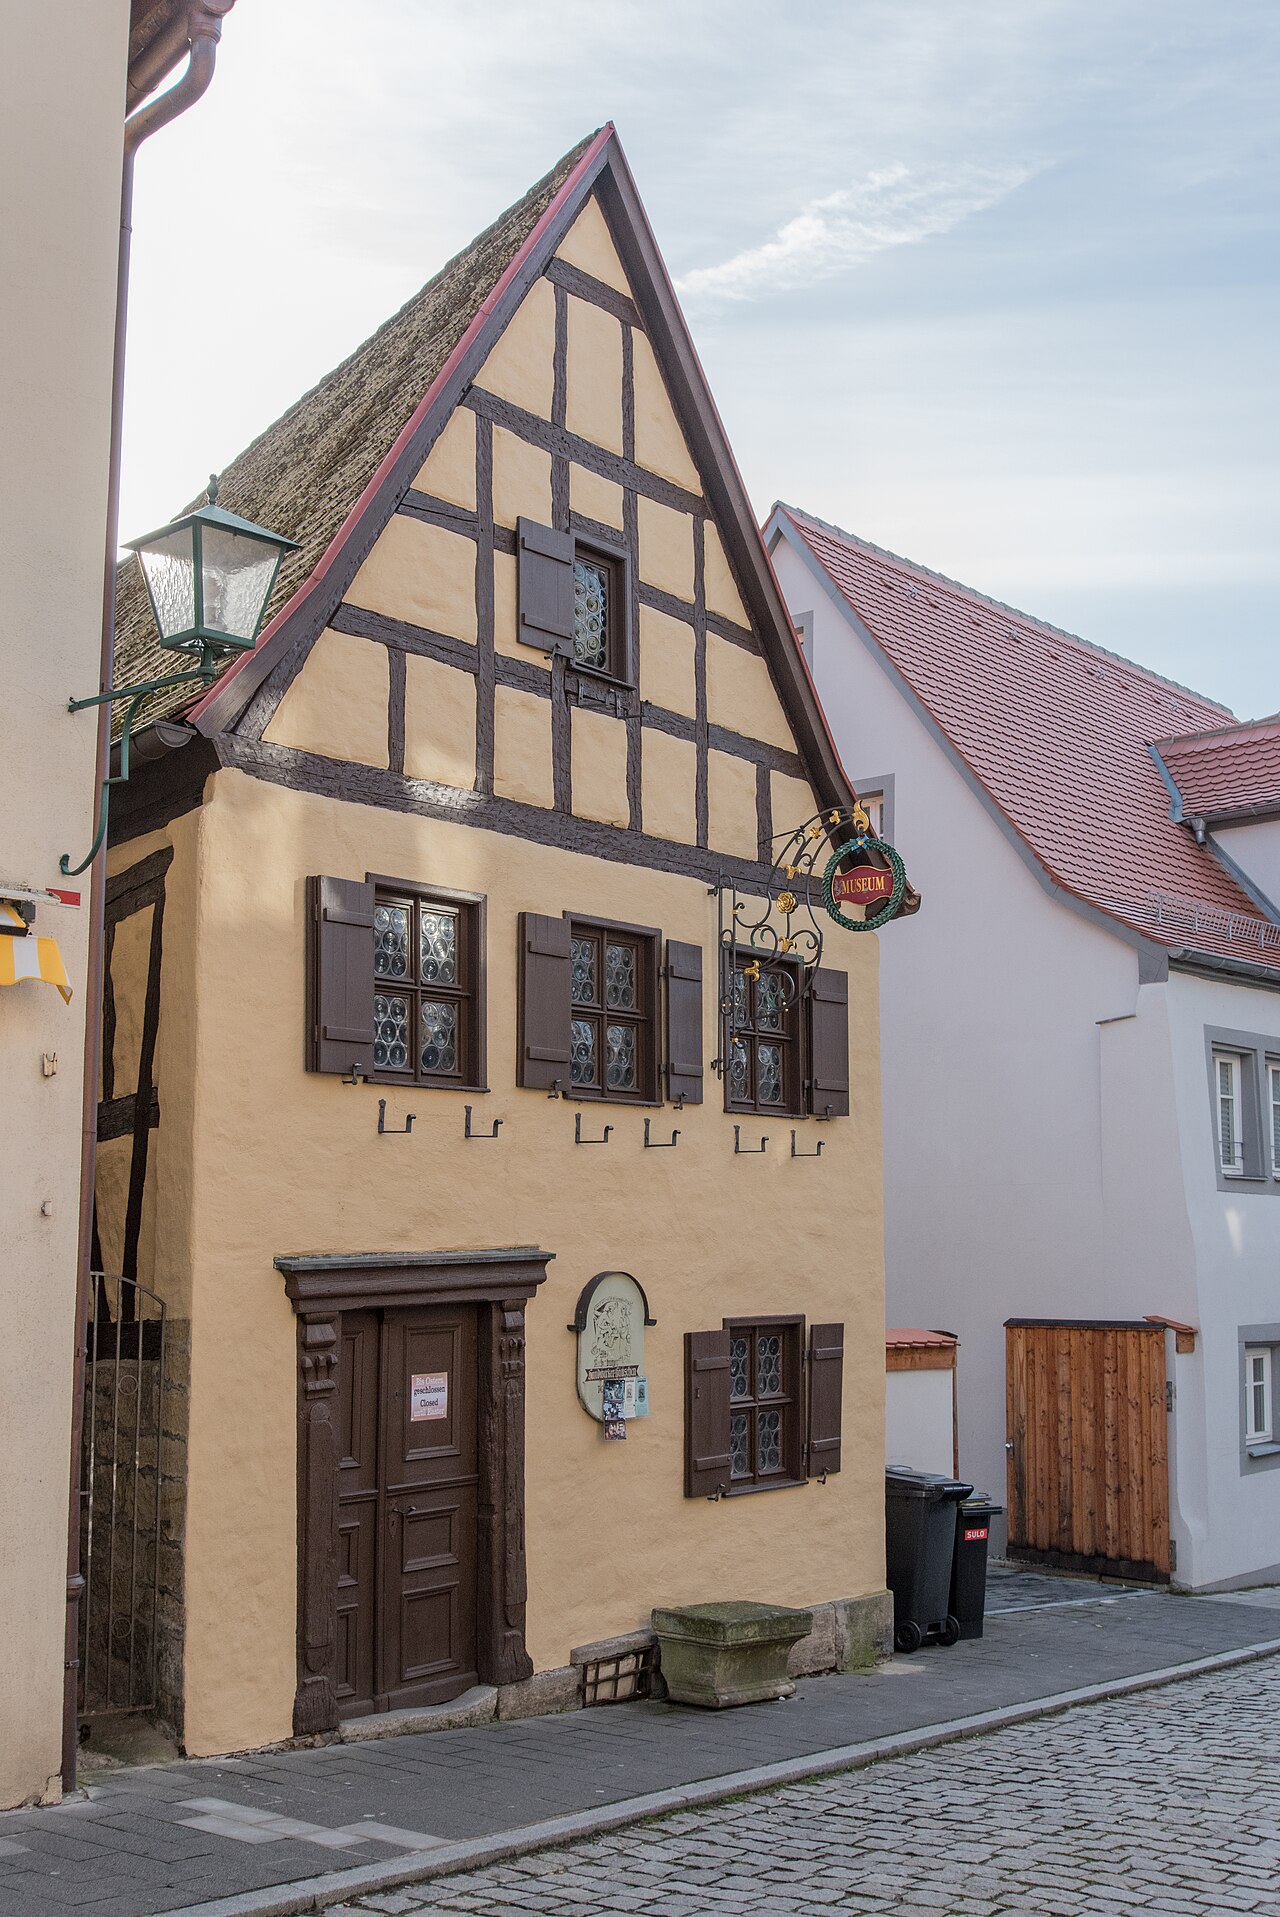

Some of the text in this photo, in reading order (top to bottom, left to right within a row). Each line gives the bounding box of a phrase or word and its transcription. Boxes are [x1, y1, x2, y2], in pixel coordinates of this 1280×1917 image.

[841, 876, 885, 895] MUSEUM
[426, 1377, 444, 1385] Ostern
[414, 1386, 445, 1397] geschlossen
[420, 1398, 439, 1407] Closed
[967, 1530, 985, 1539] SULO
